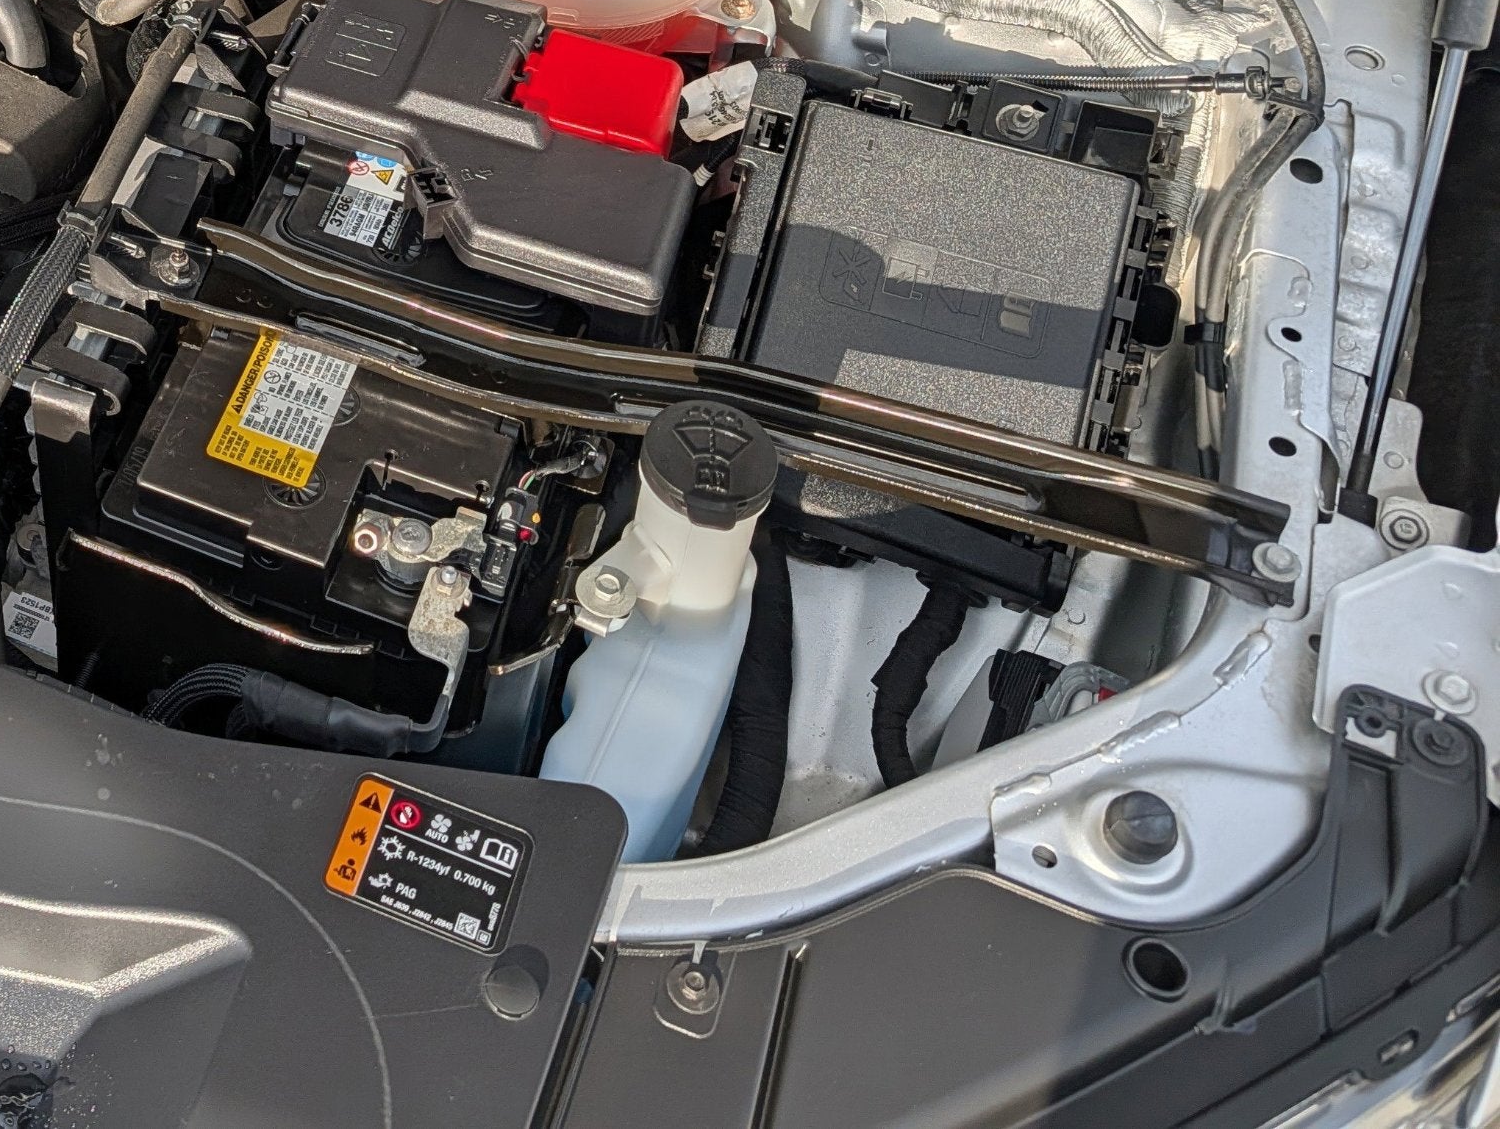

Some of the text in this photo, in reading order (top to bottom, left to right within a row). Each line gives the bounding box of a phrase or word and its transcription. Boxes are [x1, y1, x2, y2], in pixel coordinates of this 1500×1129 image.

[382, 206, 404, 247] ACDelco
[425, 829, 449, 844] AUTO
[406, 850, 496, 896] R-1234yf 0.700 kg
[380, 894, 394, 906] SAE
[395, 882, 417, 900] PAG
